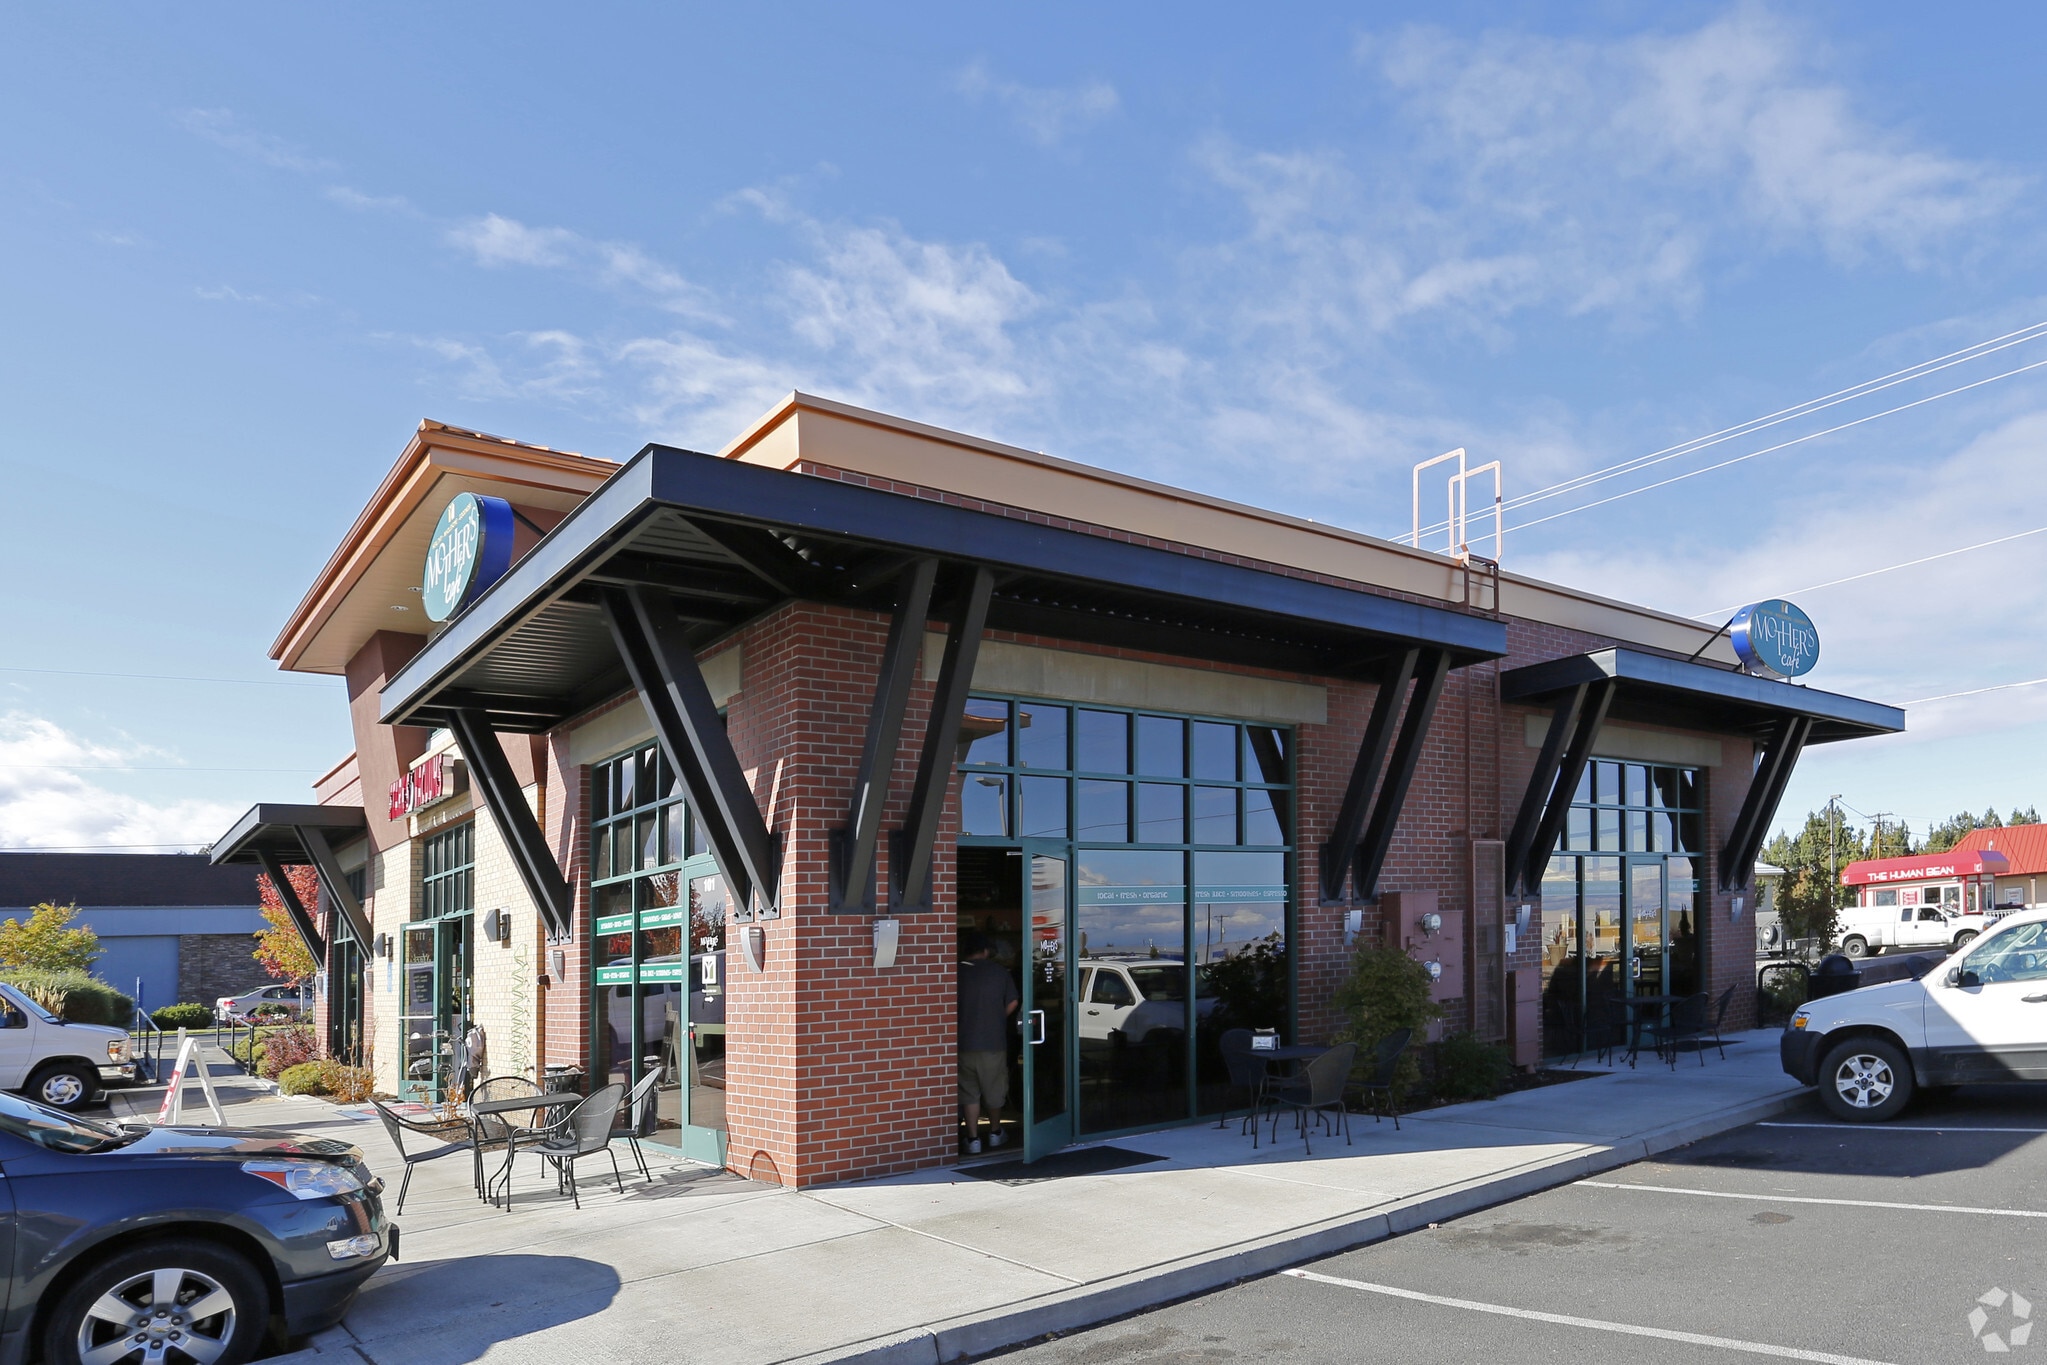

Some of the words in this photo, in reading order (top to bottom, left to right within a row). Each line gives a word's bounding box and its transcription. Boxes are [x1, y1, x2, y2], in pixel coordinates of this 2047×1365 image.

[426, 507, 478, 594] MOTHER'S
[1754, 613, 1815, 656] MOTHER'S
[1781, 643, 1800, 675] café
[703, 878, 715, 893] 101
[1867, 872, 1887, 881] THE
[1889, 868, 1924, 880] HUMAN
[1926, 865, 1954, 876] BEAN
